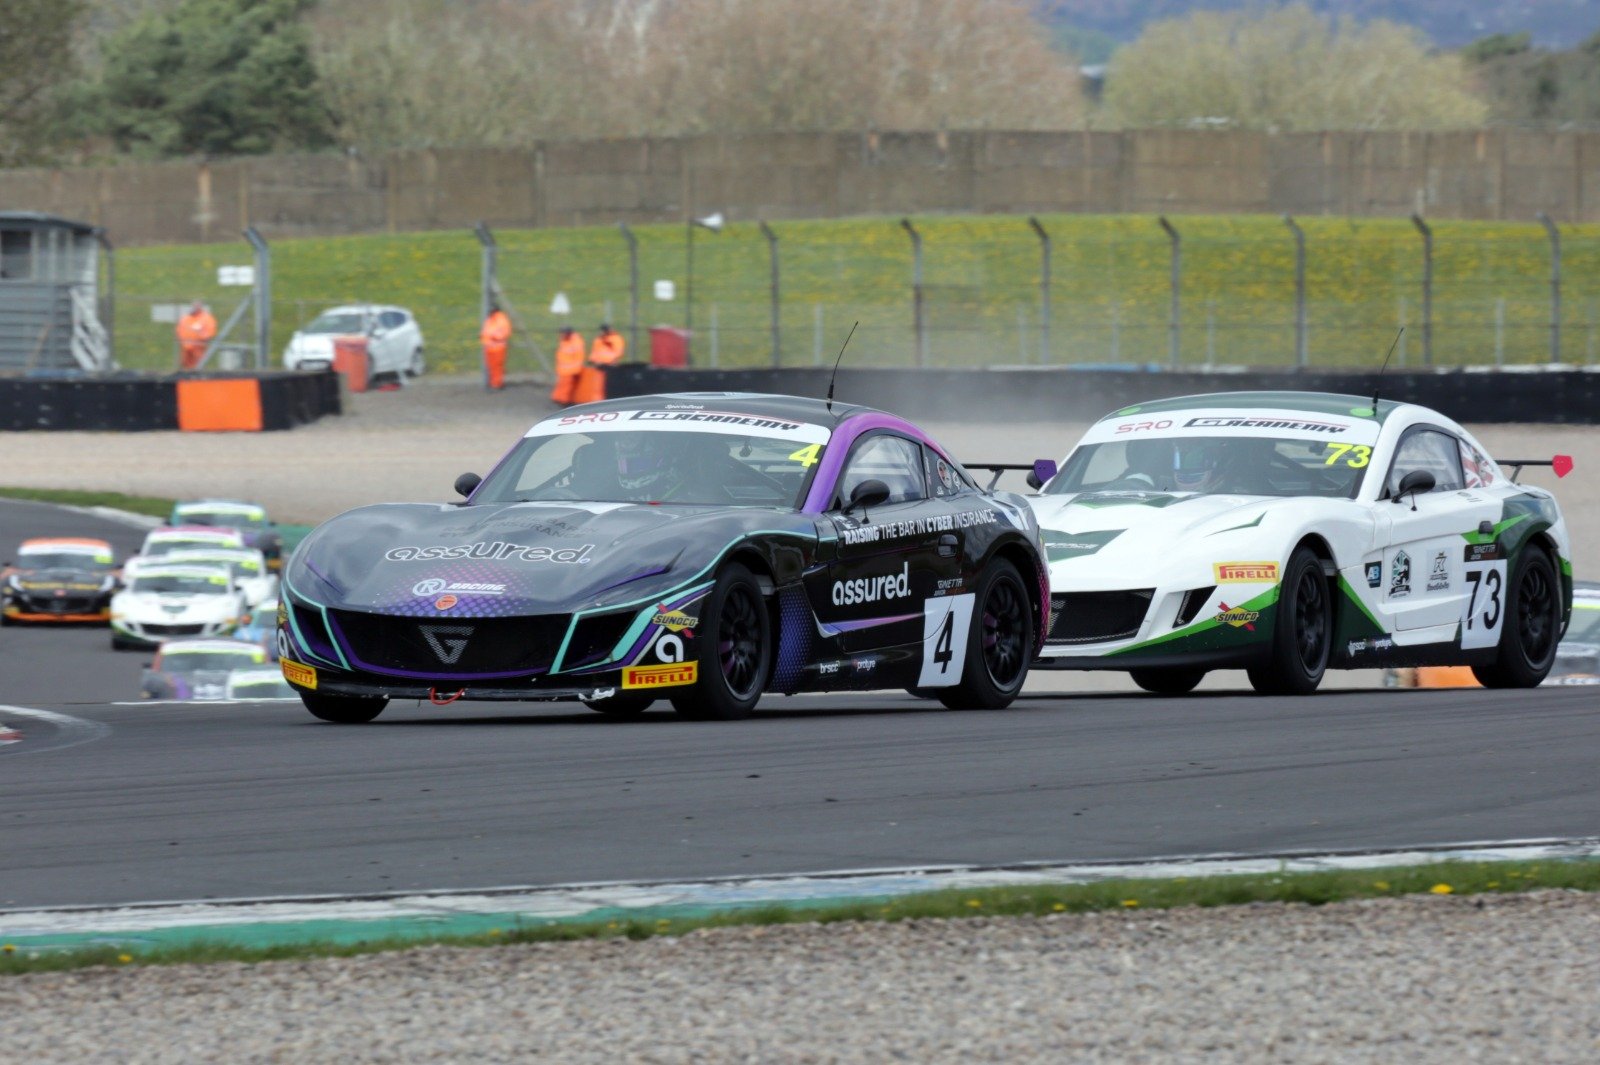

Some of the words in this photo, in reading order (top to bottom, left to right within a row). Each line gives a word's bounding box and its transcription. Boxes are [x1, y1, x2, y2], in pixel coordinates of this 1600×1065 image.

[1114, 419, 1173, 434] SRO
[788, 443, 822, 468] 4
[1325, 442, 1371, 468] 73
[843, 526, 881, 545] RAISING
[880, 522, 897, 540] THE
[899, 520, 917, 537] BAR
[916, 517, 927, 534] IN
[926, 514, 953, 532] CYBER
[385, 541, 595, 564] assured.
[832, 561, 912, 606] assured.
[1219, 565, 1276, 579] PIRELLI
[1465, 569, 1502, 630] 73
[653, 615, 696, 627] SUNOCO
[1217, 612, 1258, 621] SUNOCO
[933, 611, 954, 674] 4
[629, 666, 693, 685] PIRELLI
